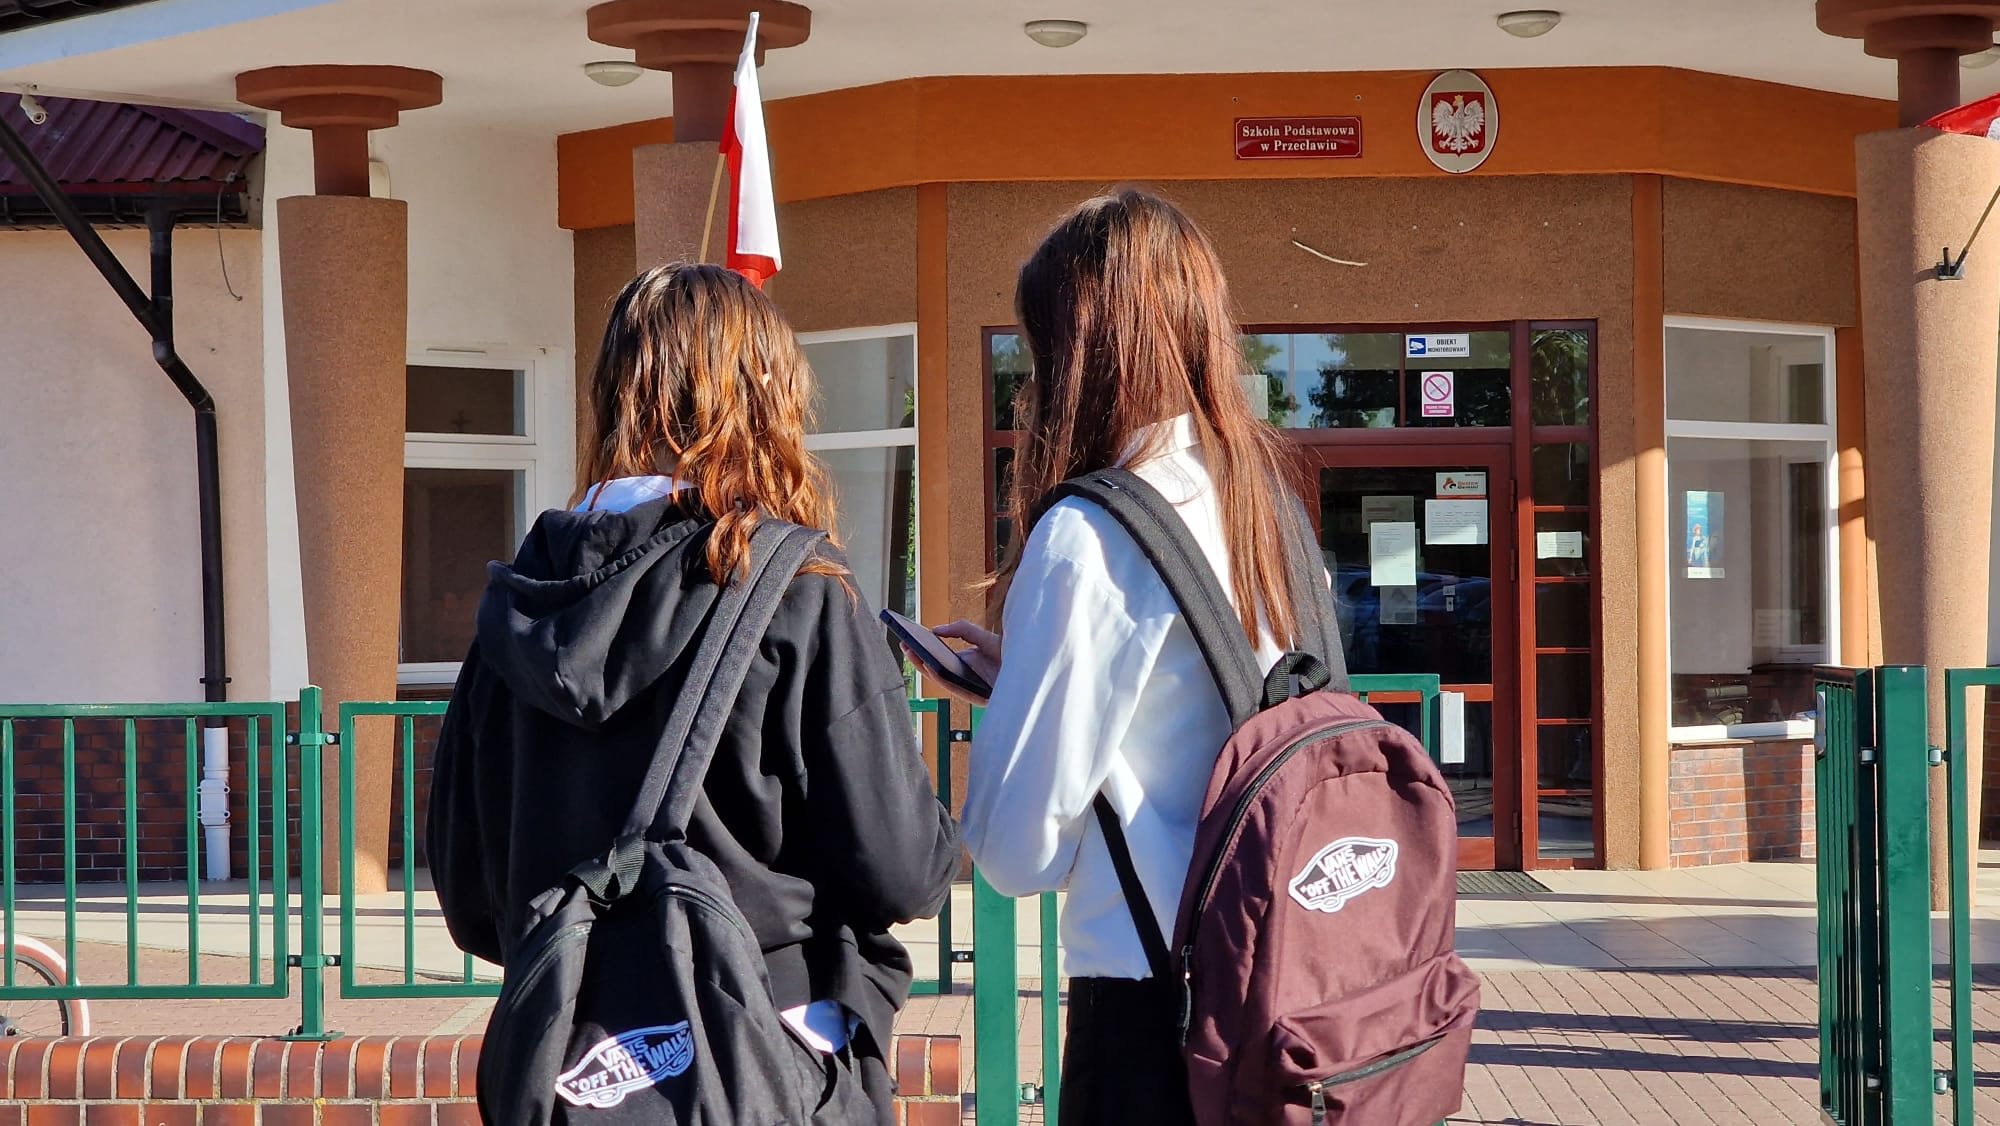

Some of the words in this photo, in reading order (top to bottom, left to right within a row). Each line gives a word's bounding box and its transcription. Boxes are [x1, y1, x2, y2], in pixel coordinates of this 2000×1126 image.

[1242, 125, 1280, 137] Szkoła
[1284, 125, 1355, 136] Podstawowa
[1260, 143, 1269, 151] w
[1274, 139, 1337, 151] Przecławiu
[1317, 845, 1357, 876] VANS
[1329, 864, 1360, 890] THE
[596, 1036, 649, 1068] VANS
[608, 1055, 649, 1082] THE
